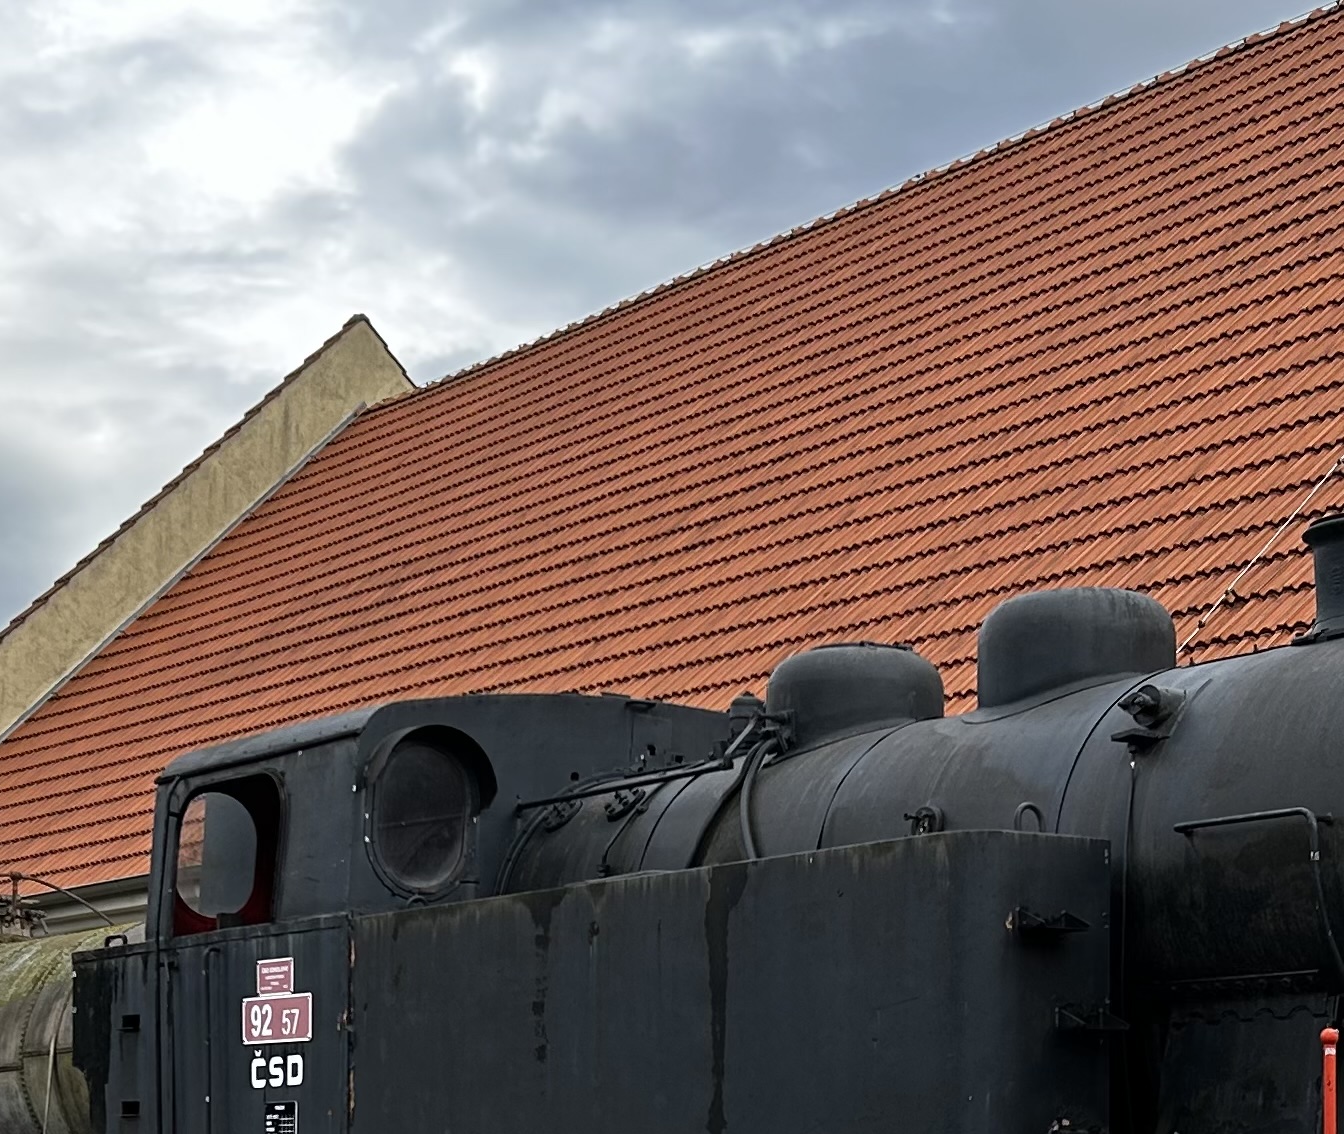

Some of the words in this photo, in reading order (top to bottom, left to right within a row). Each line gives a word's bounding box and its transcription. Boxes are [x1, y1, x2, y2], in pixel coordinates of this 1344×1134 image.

[250, 1003, 273, 1037] 92
[281, 1008, 300, 1035] 57
[251, 1049, 304, 1089] ČSD
